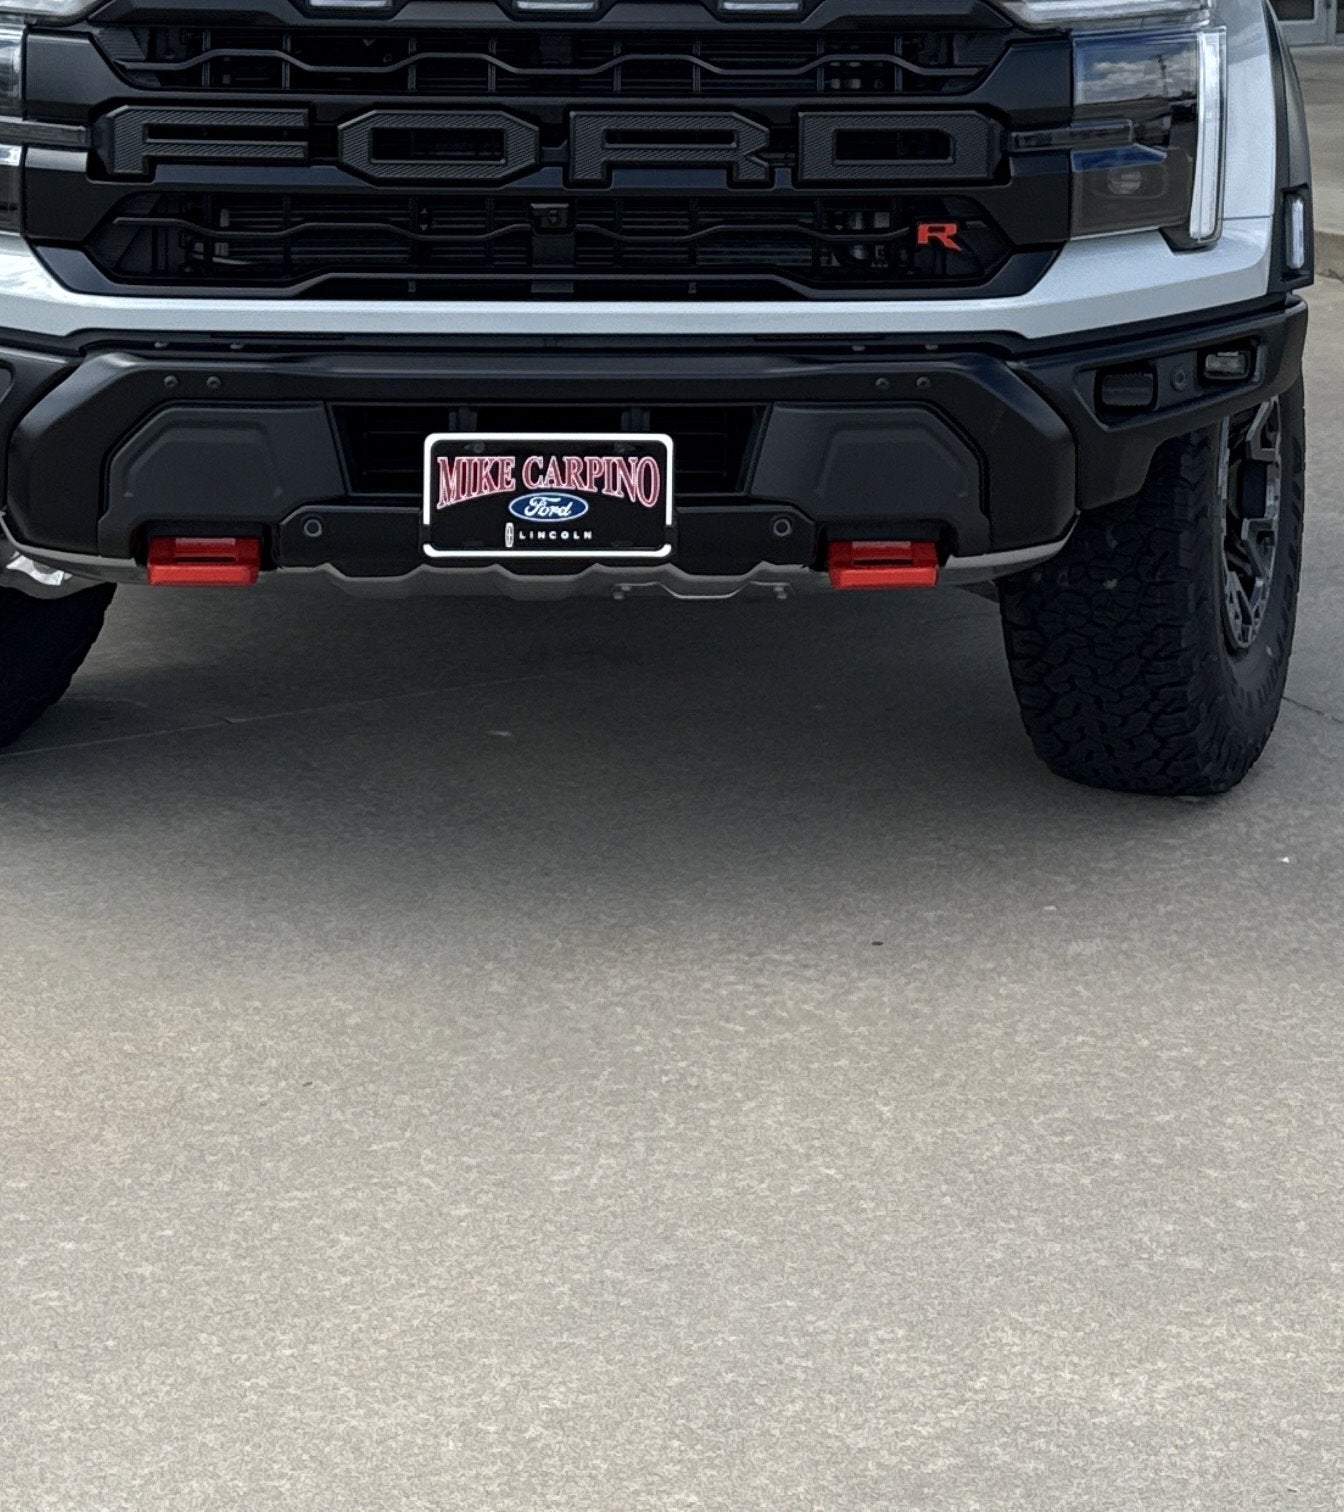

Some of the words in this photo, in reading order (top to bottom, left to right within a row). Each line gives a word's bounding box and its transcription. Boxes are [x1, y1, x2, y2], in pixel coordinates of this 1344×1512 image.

[104, 104, 1001, 181] FORD
[916, 221, 962, 251] R
[436, 455, 516, 510] MIKE
[521, 455, 661, 509] CARPINO
[524, 496, 572, 518] Ford
[519, 530, 593, 540] LINCOLN
